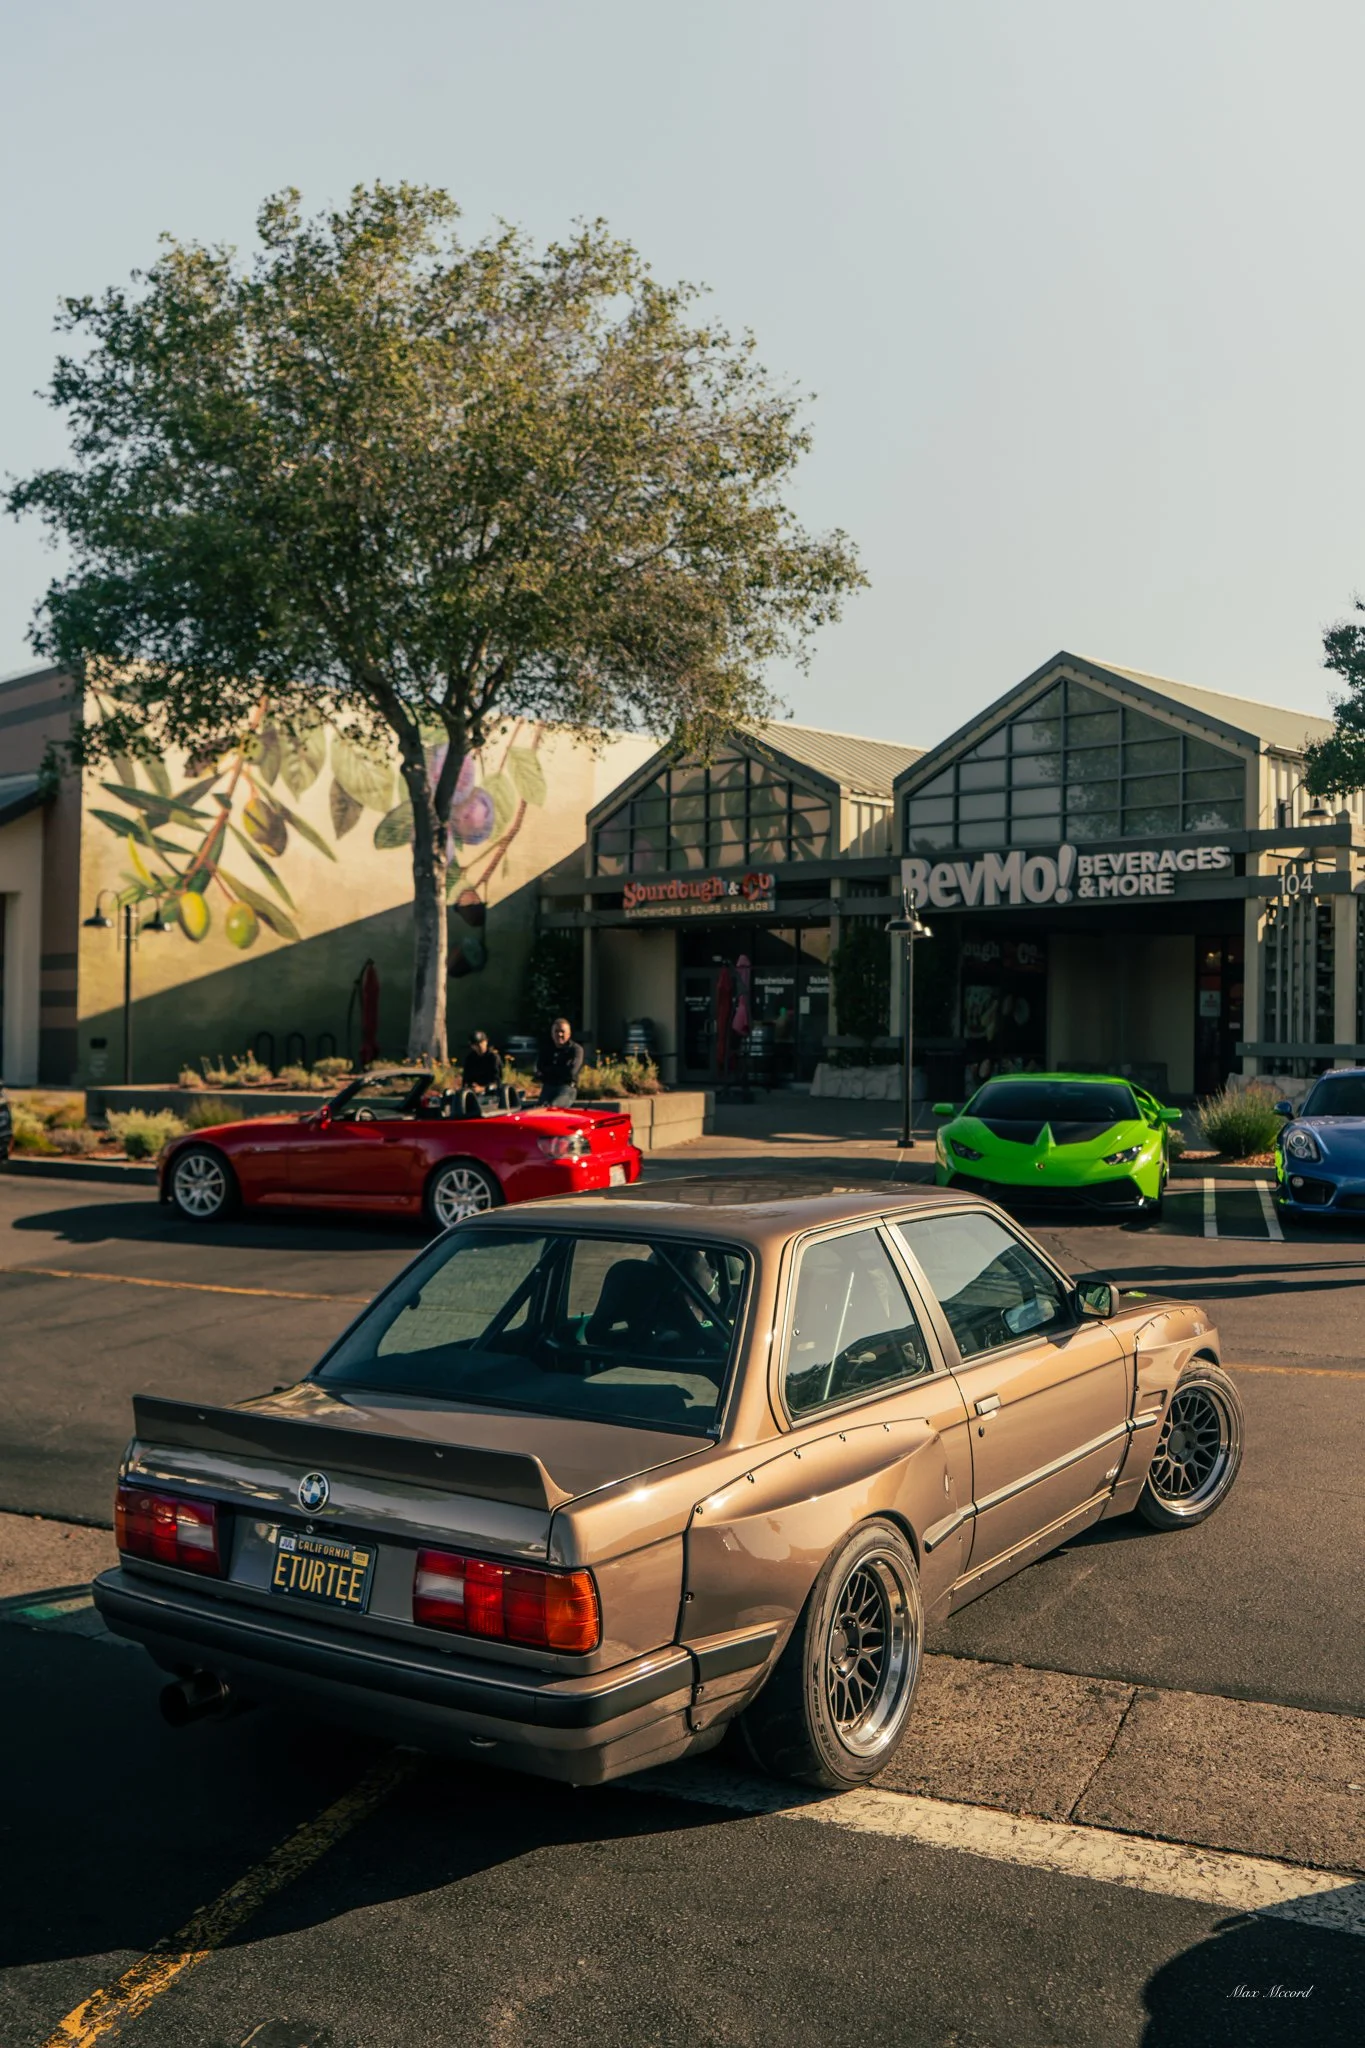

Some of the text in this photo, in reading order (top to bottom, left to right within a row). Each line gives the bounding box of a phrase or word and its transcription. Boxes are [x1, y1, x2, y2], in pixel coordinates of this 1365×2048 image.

[901, 844, 1077, 908] BevMo!
[1078, 846, 1231, 877] BEVERAGES
[623, 876, 725, 909] Sourdough
[728, 881, 739, 896] &
[1277, 874, 1313, 896] 104
[624, 902, 769, 918] SANDWICHES SOUPS SALADS
[298, 1540, 350, 1559] CALIFORNIA
[273, 1552, 365, 1603] ETURTEE
